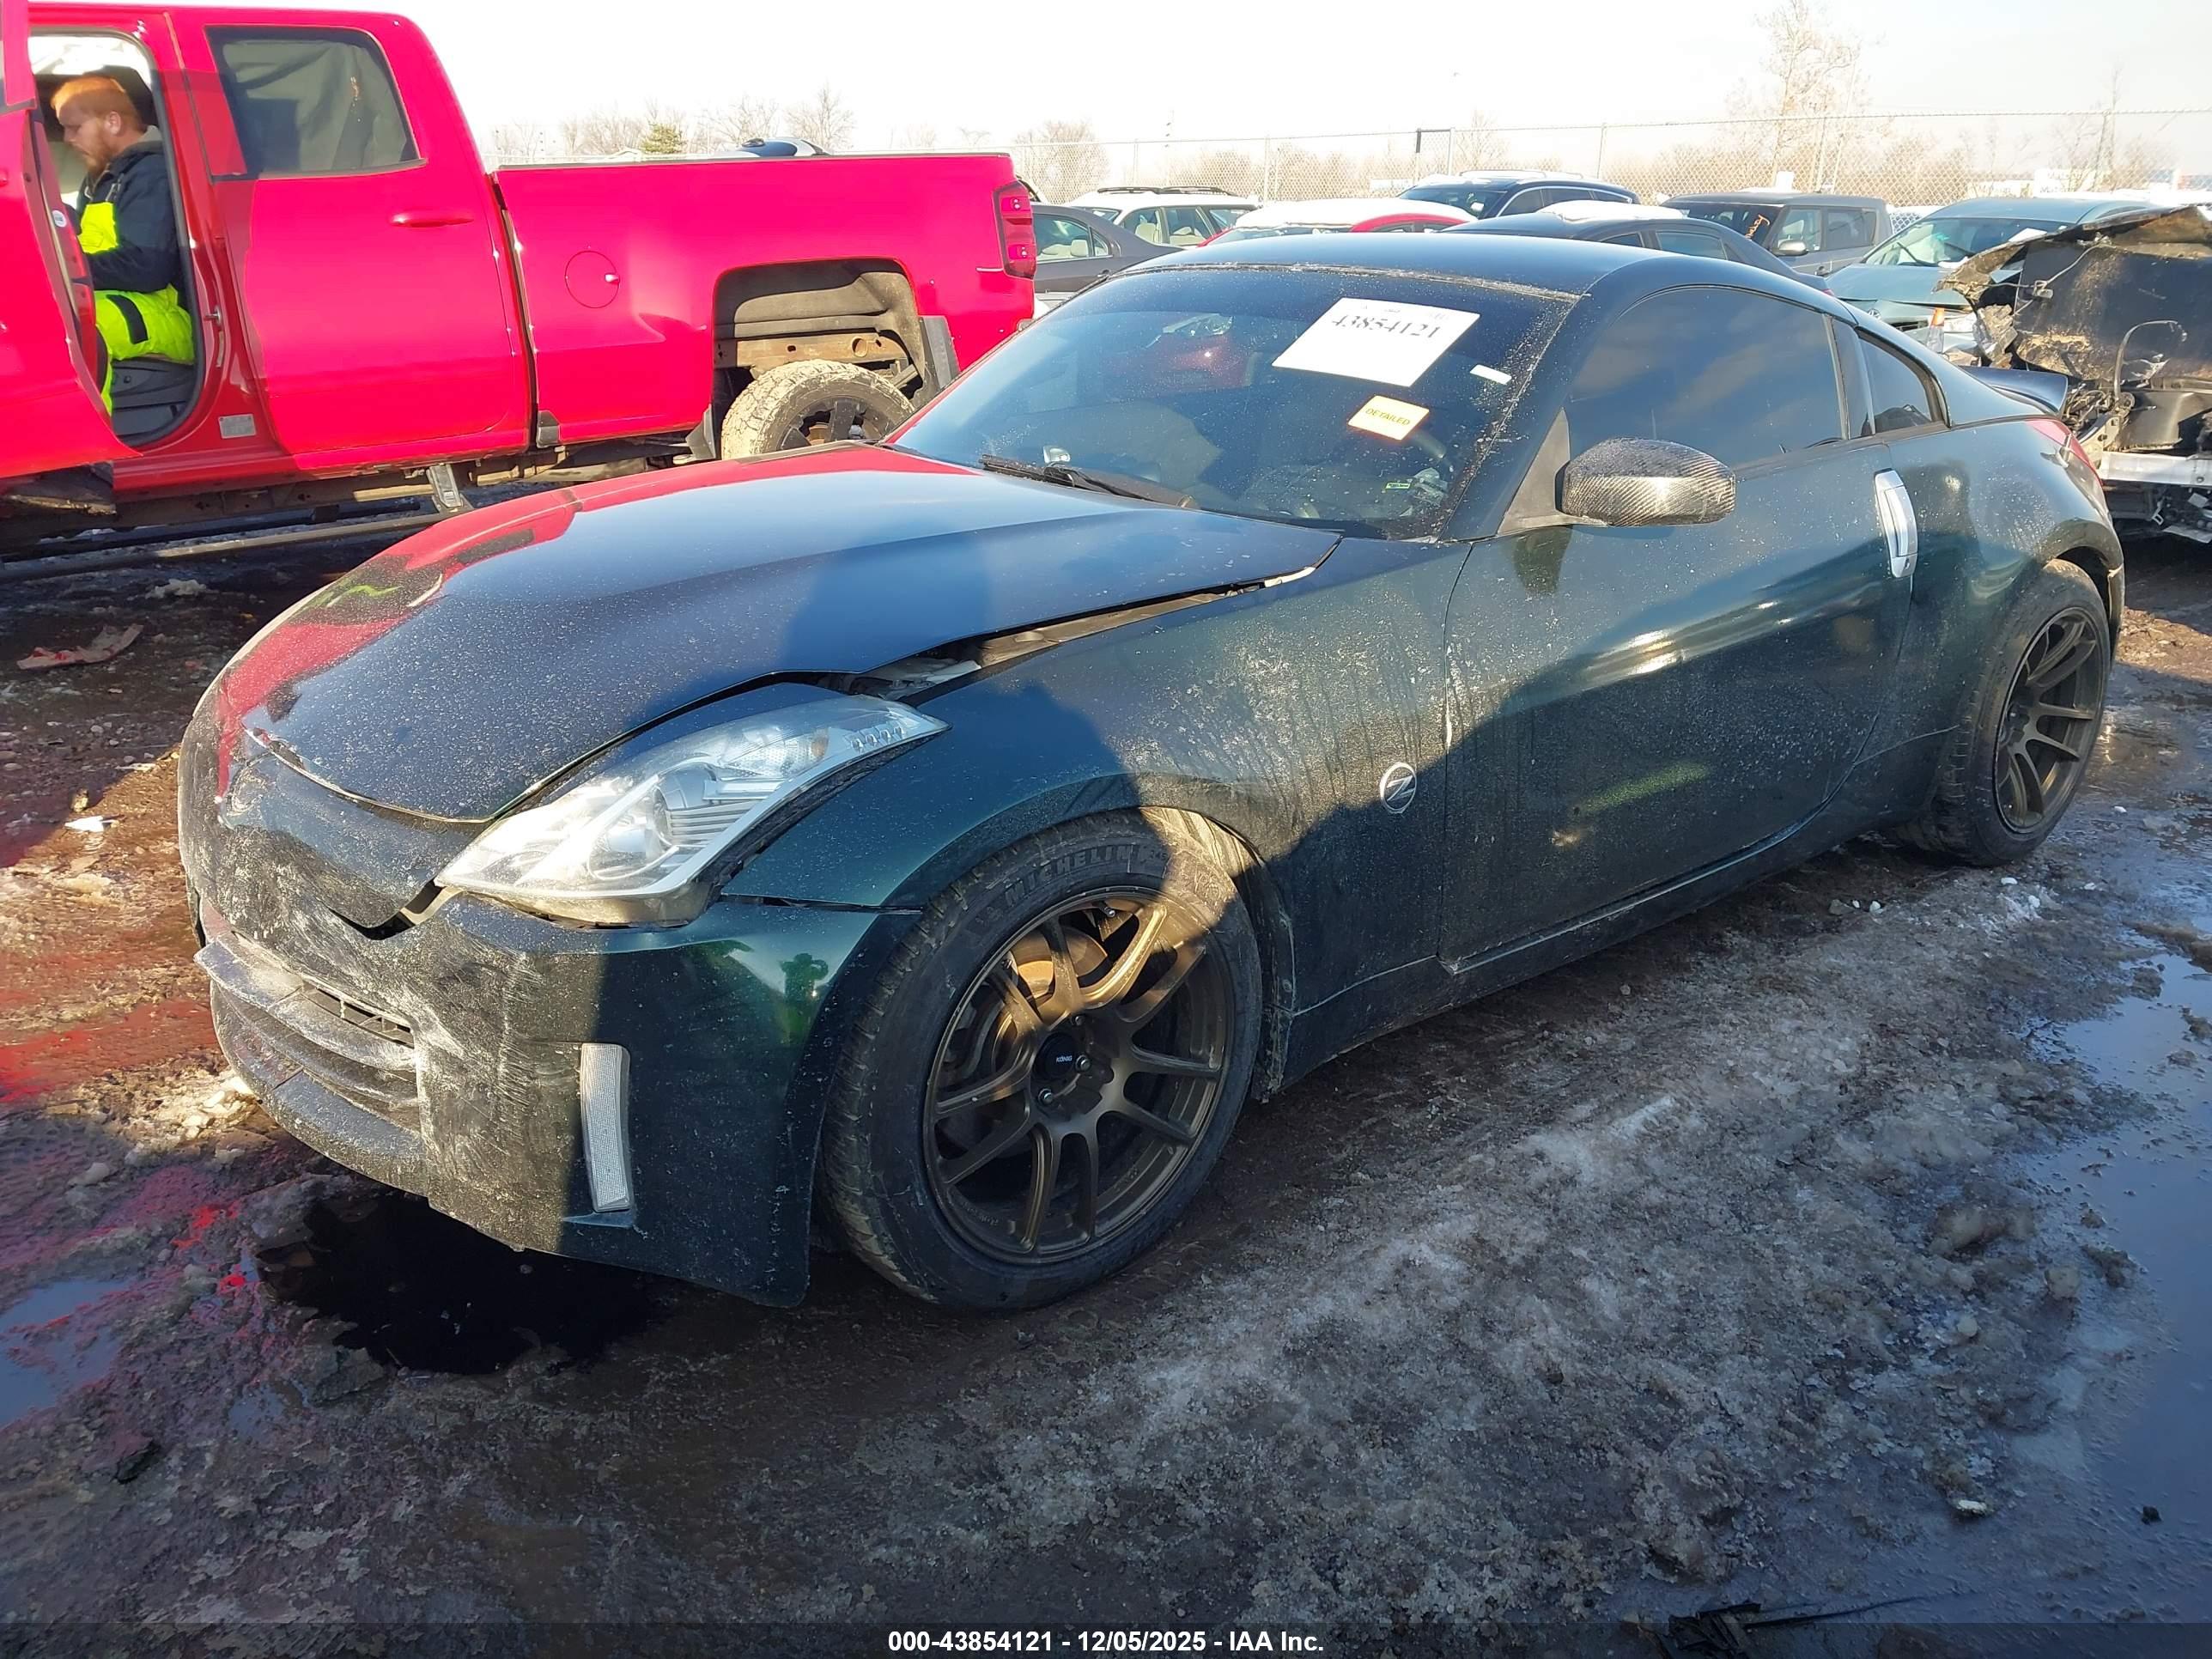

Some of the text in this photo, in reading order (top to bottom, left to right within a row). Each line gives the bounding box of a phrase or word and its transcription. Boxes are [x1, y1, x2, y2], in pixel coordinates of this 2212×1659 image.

[1332, 314, 1441, 338] 43854121
[1365, 408, 1411, 426] DETAILED
[1004, 844, 1133, 908] MICHELIN
